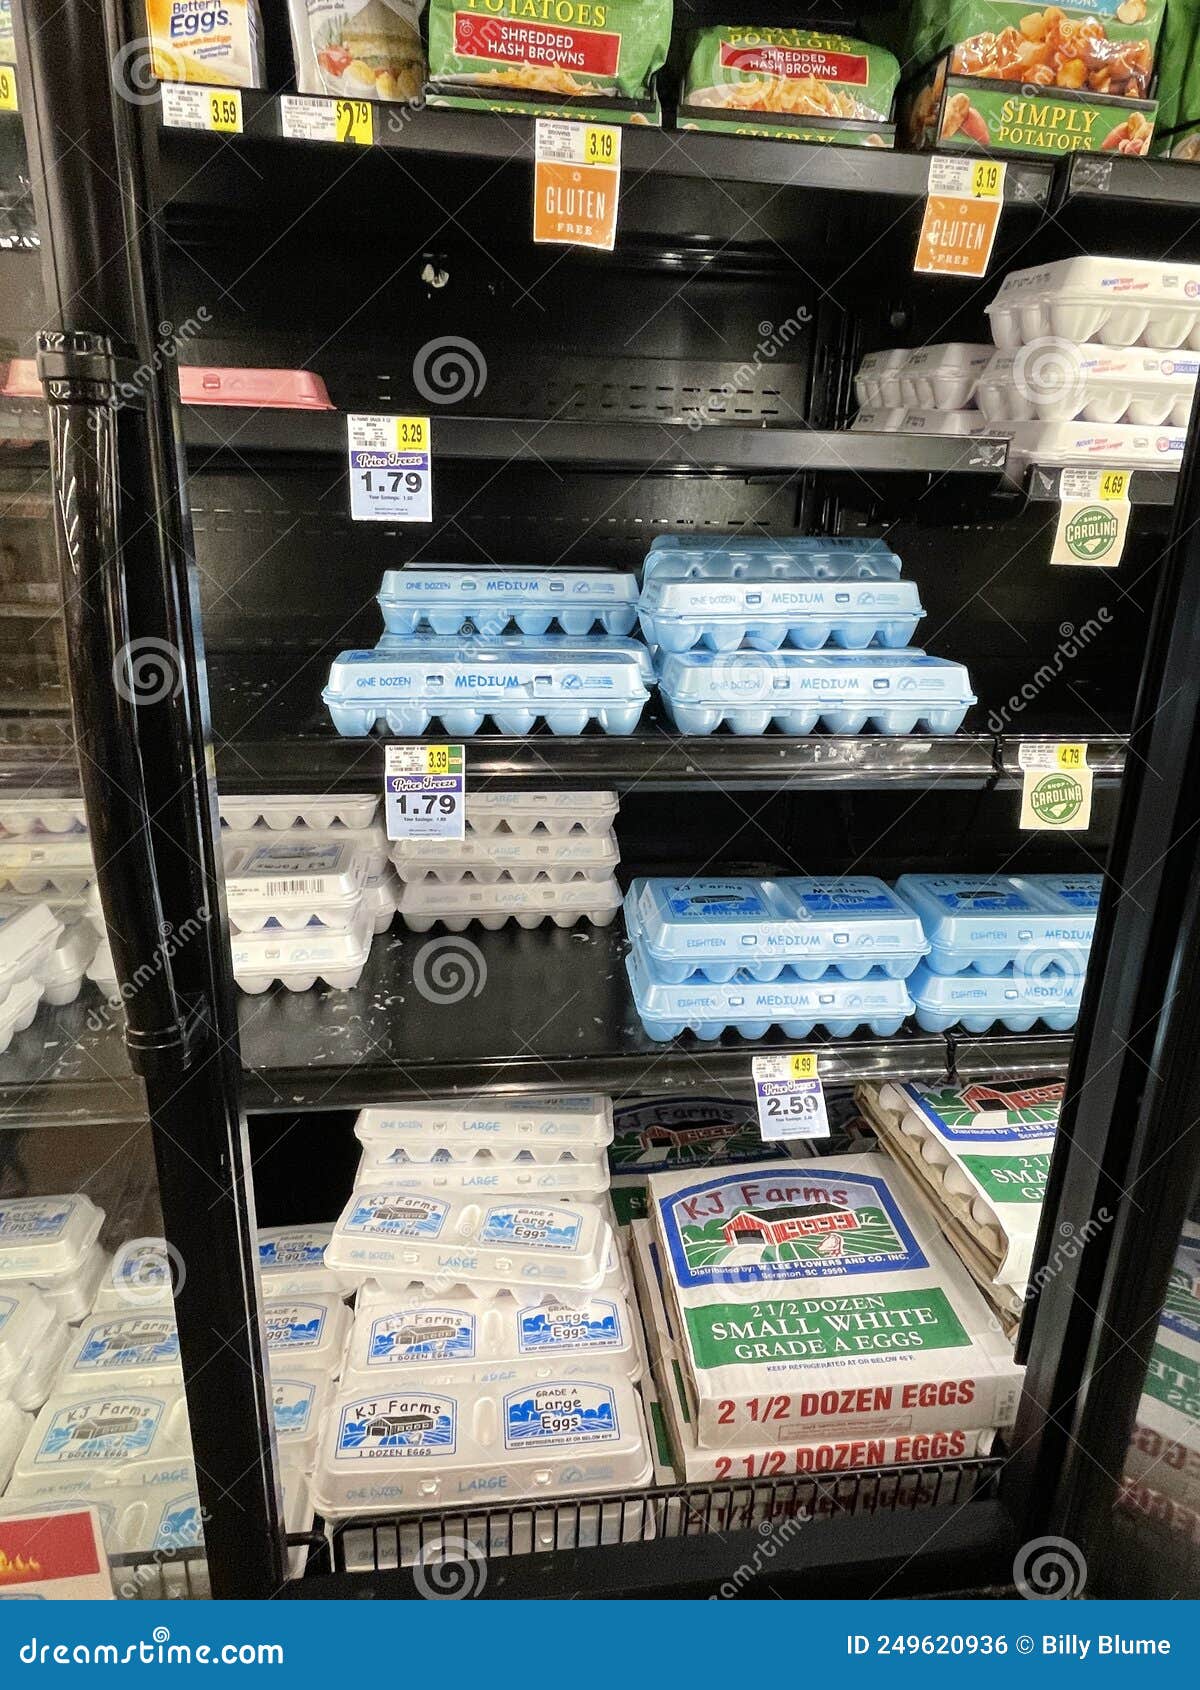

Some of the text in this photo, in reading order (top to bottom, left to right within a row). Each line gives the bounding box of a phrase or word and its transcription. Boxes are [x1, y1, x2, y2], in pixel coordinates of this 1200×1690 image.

[500, 26, 574, 49] SHREDDED
[488, 41, 585, 66] HASH BROWNS
[760, 51, 826, 64] SHREDDED
[750, 58, 838, 76] HASH BROWNS
[212, 100, 236, 124] 3.59
[1001, 100, 1100, 133] SIMPLY
[590, 134, 612, 156] 3.19
[998, 126, 1092, 150] POTATOES
[976, 166, 997, 190] 3.19
[546, 186, 606, 220] GLUTEN
[557, 223, 593, 236] FREE
[930, 219, 986, 250] GLUTEN
[937, 255, 969, 266] FREE
[402, 423, 422, 443] 3.29
[358, 452, 422, 467] Price Freeze
[361, 471, 422, 493] 1.79
[1104, 476, 1123, 494] 4.69
[1084, 515, 1102, 523] SHOP
[1067, 519, 1117, 542] CAROLINA
[406, 581, 539, 591] ONE DOZEN MEDIUM
[771, 592, 824, 604] MEDIUM
[356, 674, 520, 689] ONE DOZEN MEDIUM
[800, 678, 859, 690] MEDIUM
[429, 751, 447, 768] 3.39
[393, 776, 457, 792] Price Freeze
[1032, 785, 1082, 808] CAROLINA
[396, 795, 456, 815] 1.79
[687, 935, 821, 948] EIGHTEEN MEDIUM
[1045, 930, 1092, 940] MEDIUM
[1024, 987, 1074, 997] MEDIUM
[756, 995, 810, 1006] MEDIUM
[794, 1057, 811, 1072] 4.99
[762, 1083, 786, 1096] Price
[767, 1095, 818, 1117] 2.59
[463, 1121, 502, 1131] LARGE
[951, 1127, 1002, 1135] Distributed
[1025, 1124, 1041, 1132] LEE
[461, 1175, 500, 1186] LARGE
[990, 1169, 1049, 1185] SMA
[369, 1196, 438, 1212] KJ Farms
[681, 1185, 849, 1220] KJ Farms
[513, 1214, 555, 1227] Large
[515, 1226, 546, 1239] Eggs
[277, 1250, 307, 1261] Eggs
[437, 1255, 478, 1269] LARGE
[690, 1252, 910, 1277] Distributed by: W. LEE FLOWERS AND CO. INC.
[805, 1267, 847, 1277] SC 29591
[752, 1296, 886, 1318] 2 1/2 DOZEN
[265, 1316, 298, 1327] arge
[415, 1314, 463, 1326] Farms
[547, 1312, 590, 1324] Large
[711, 1307, 939, 1341] SMALL WHITE
[266, 1329, 290, 1341] ggs
[553, 1326, 587, 1339] Eggs
[735, 1331, 923, 1361] GRADE A EGGS
[397, 1352, 428, 1361] DOZEN
[767, 1356, 897, 1373] KEEP REFRIGERATED AT OR BELOW
[536, 1389, 567, 1398] GRADE
[355, 1399, 442, 1419] KJ Farms
[535, 1399, 582, 1412] Large
[718, 1380, 976, 1424] 2 1/2 DOZEN EGGS
[67, 1403, 150, 1423] KJ Farms
[542, 1415, 579, 1431] Eggs
[366, 1449, 403, 1458] DOZEN
[406, 1448, 432, 1456] EGGS
[715, 1431, 966, 1480] 2 1/2 DOZEN EGGS
[143, 1468, 189, 1485] LARGE
[458, 1475, 508, 1493] LARGE
